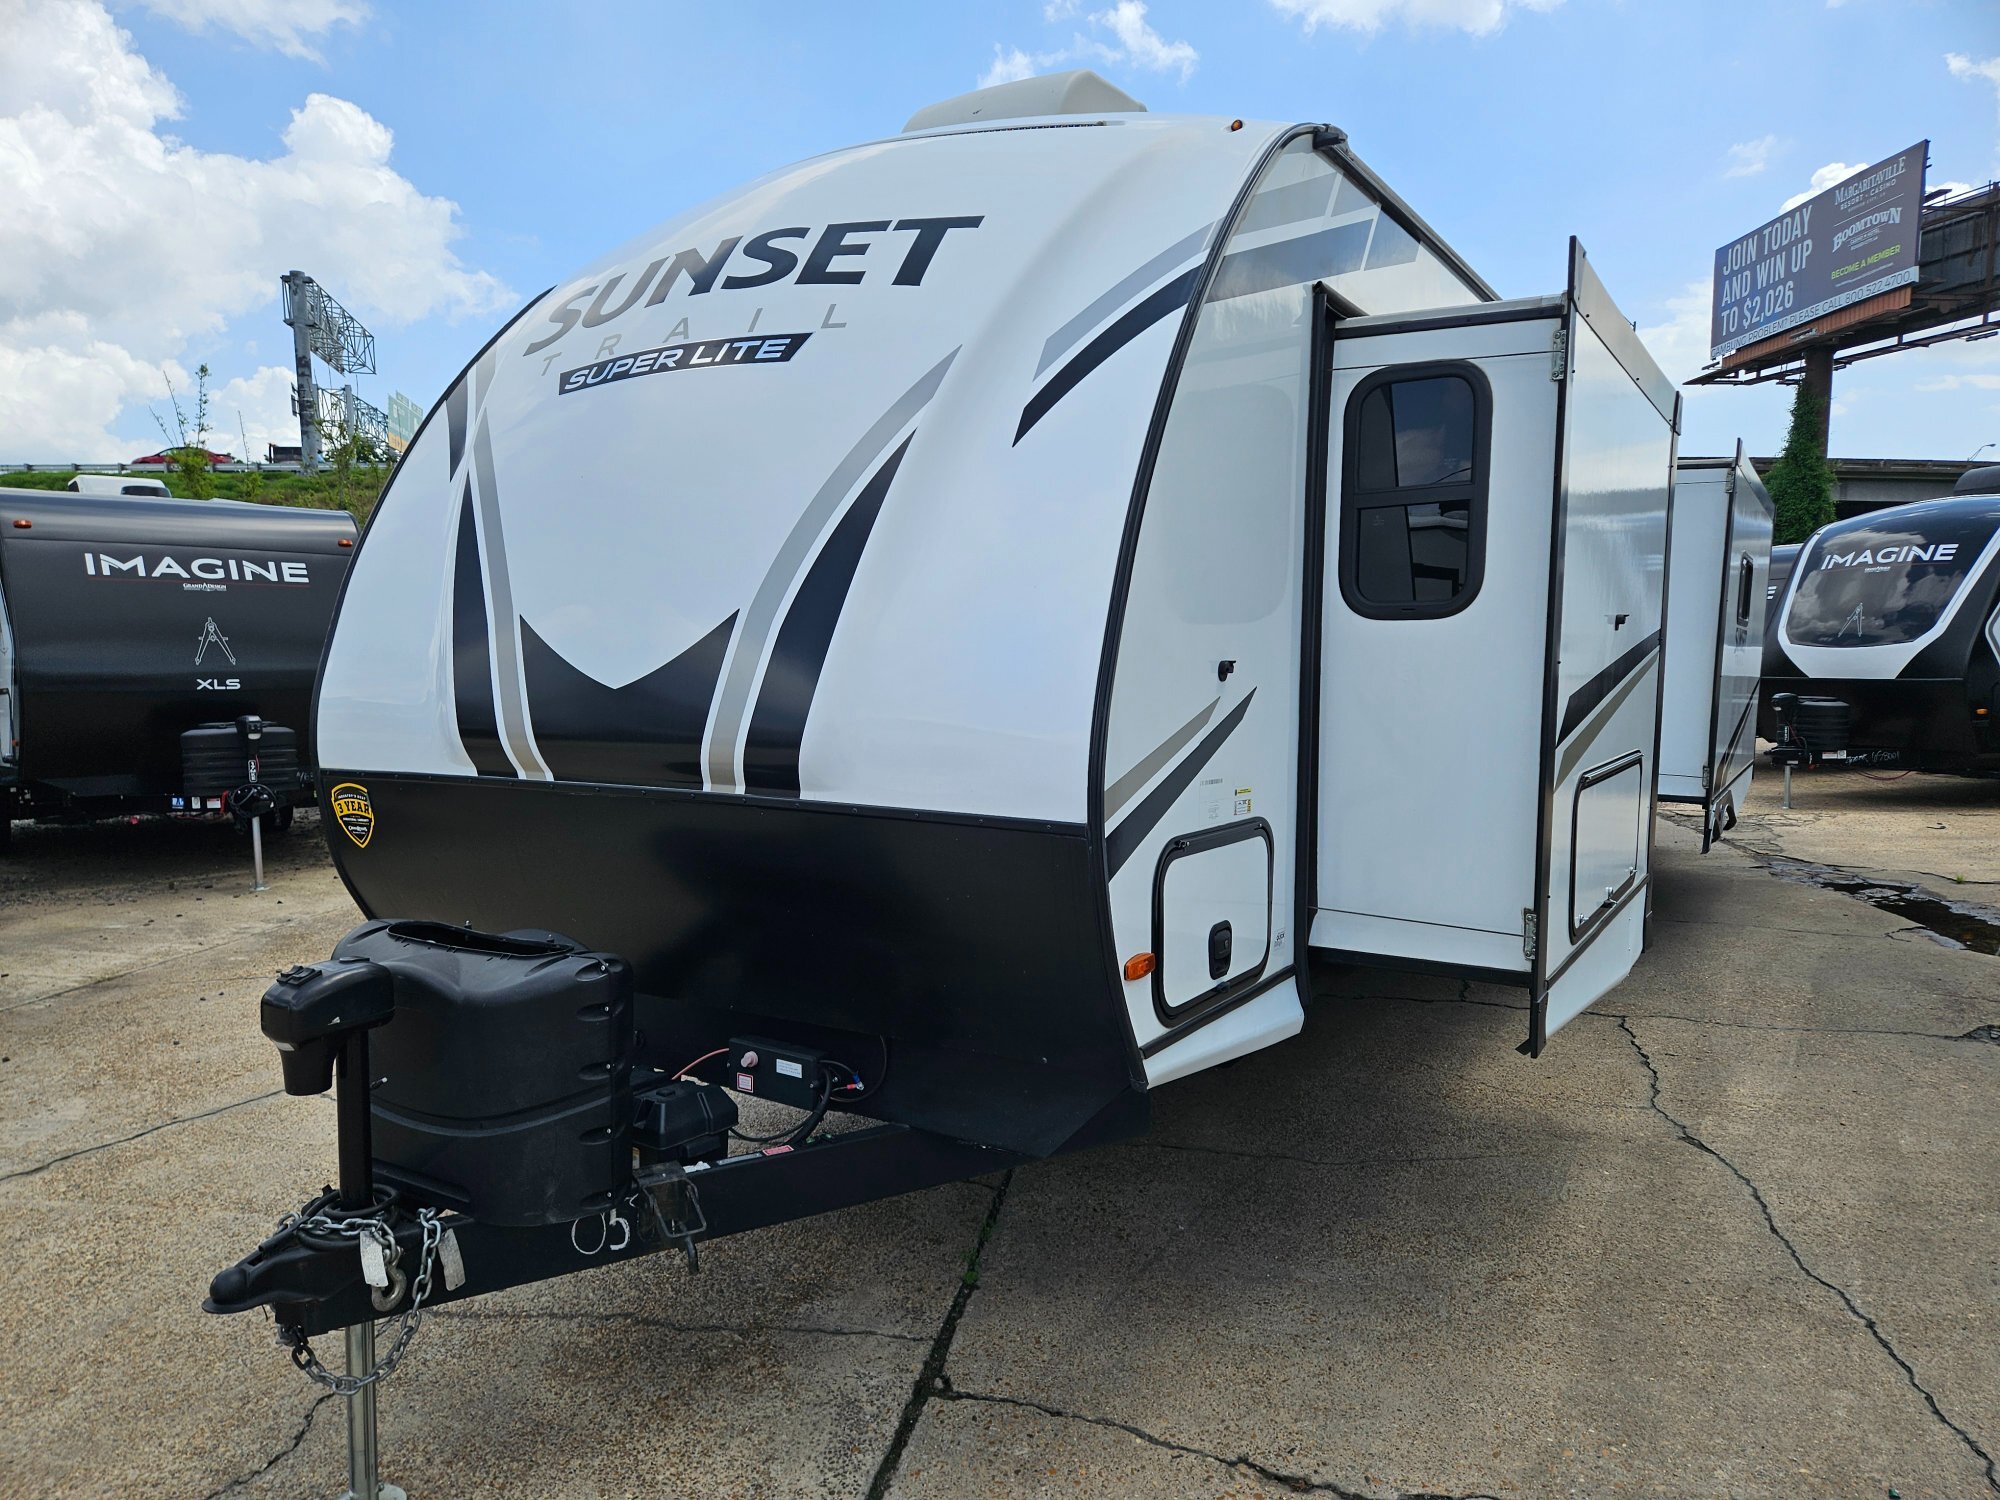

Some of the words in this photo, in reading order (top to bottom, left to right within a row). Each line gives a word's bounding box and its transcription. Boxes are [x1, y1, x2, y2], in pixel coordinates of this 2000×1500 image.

[1834, 156, 1906, 206] MARGARITAVILLE
[1869, 178, 1897, 196] CASINO
[1723, 234, 1758, 276] JOIN
[1762, 204, 1813, 256] TODAY
[1832, 207, 1902, 253] BOOMTOWN
[523, 215, 986, 357] SUNSET
[1721, 270, 1750, 308] AND
[1756, 251, 1786, 290] WIN
[1791, 238, 1813, 273] UP
[1831, 261, 1860, 280] BECOME
[1860, 259, 1866, 268] A
[1867, 244, 1901, 265] MEMBER
[1711, 335, 1747, 358] GAMBLING
[1748, 318, 1788, 343] PROBLEM?
[1789, 304, 1820, 325] PLEASE
[1822, 297, 1842, 313] CALL
[1721, 306, 1739, 337] TO
[1743, 280, 1794, 330] $2,026
[541, 303, 847, 377] TRAIL
[564, 348, 685, 391] SUPER
[689, 338, 792, 365] LITE
[84, 552, 310, 583] IMAGINE
[1821, 543, 1959, 570] IMAGINE
[196, 678, 241, 691] XLS
[337, 802, 344, 814] 3
[343, 800, 370, 815] YEAR
